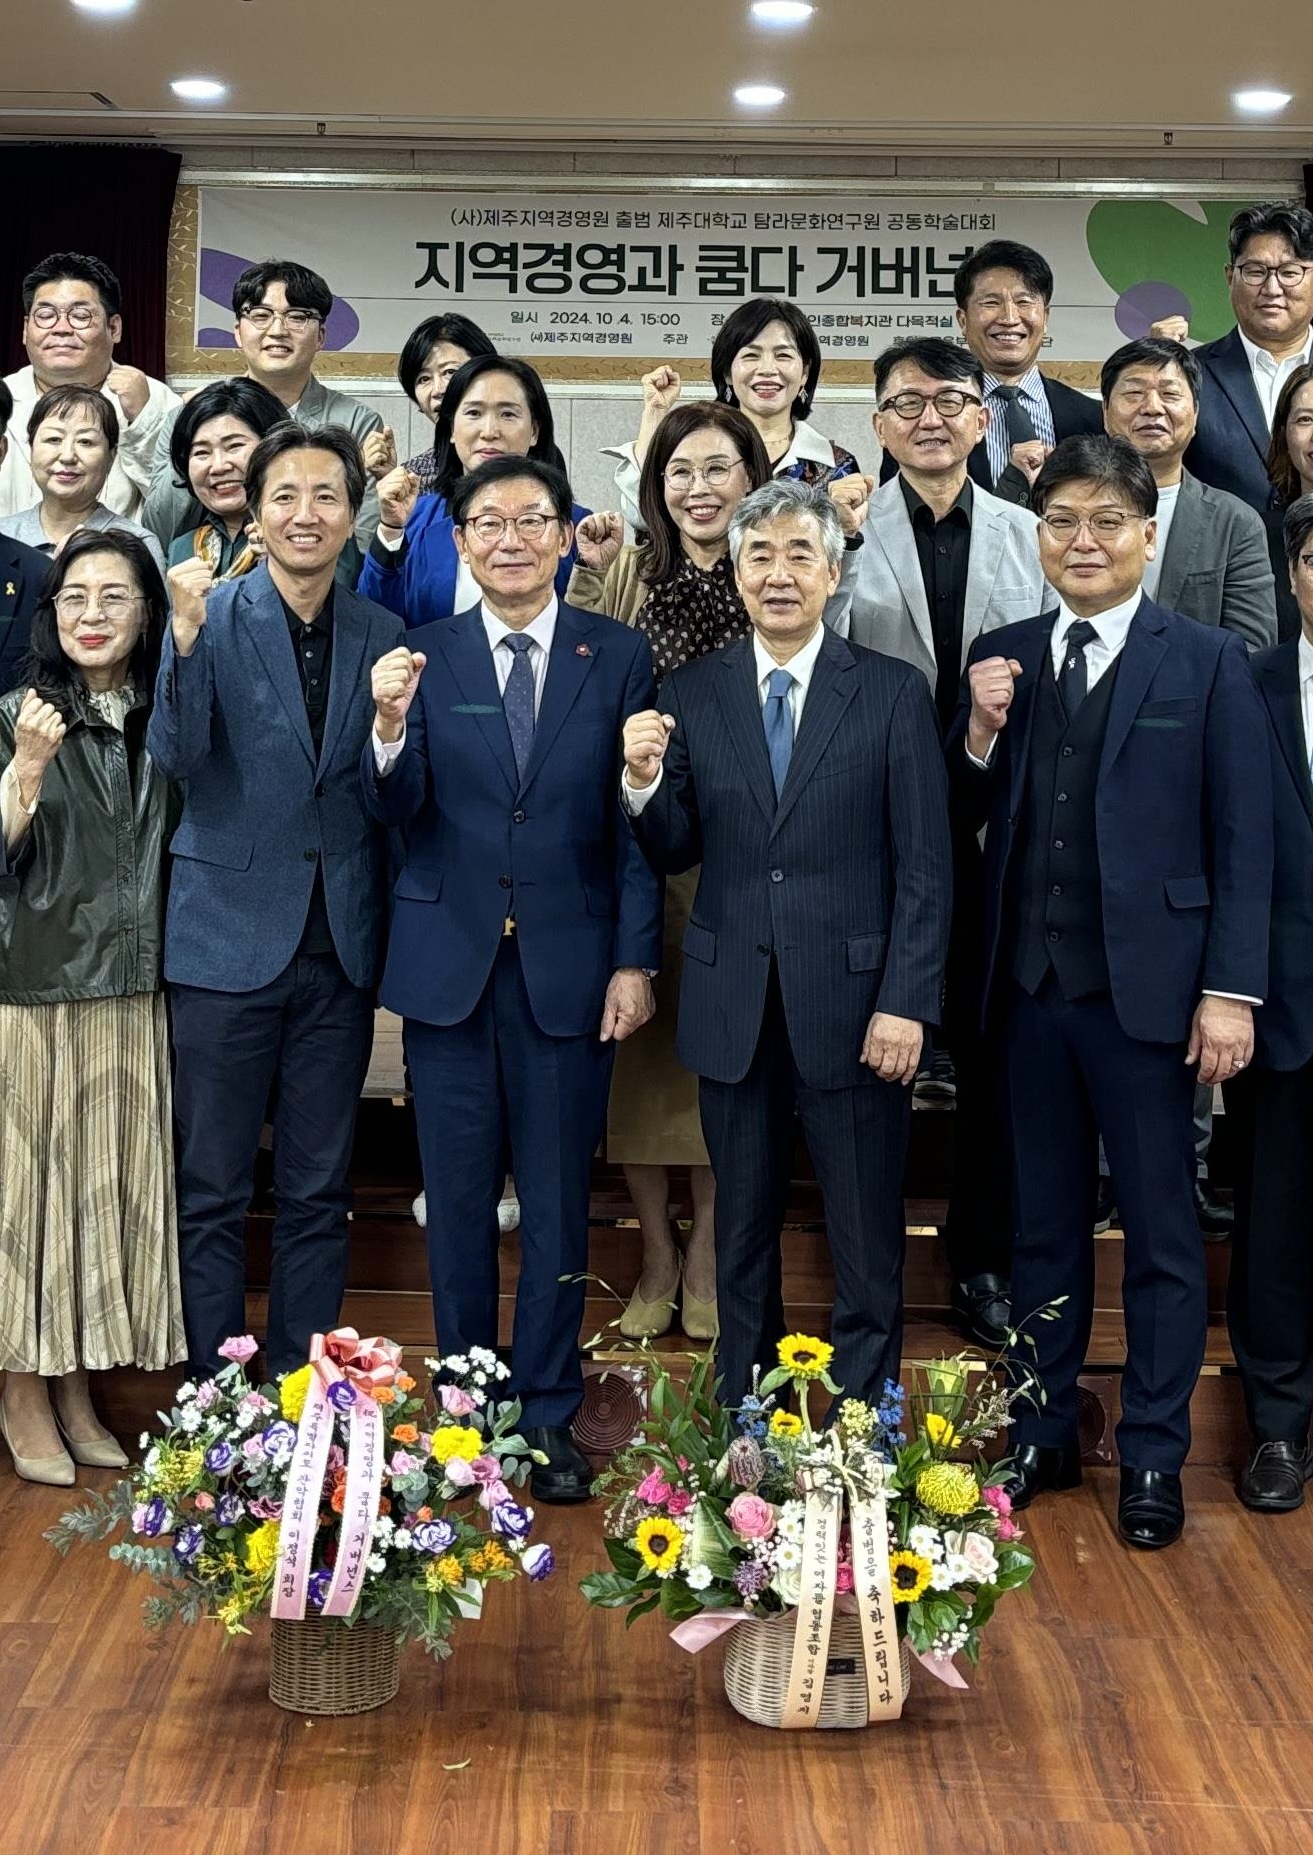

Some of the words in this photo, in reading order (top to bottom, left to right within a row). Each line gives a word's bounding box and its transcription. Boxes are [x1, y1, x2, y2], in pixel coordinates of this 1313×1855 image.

[450, 207, 610, 229] (사)제주지역경영원
[615, 210, 651, 230] 출범
[657, 211, 748, 231] 제주대학교
[753, 212, 881, 232] 탐라문화연구원
[886, 213, 996, 233] 공동학술대회
[413, 240, 685, 298] 지역경영과
[694, 244, 805, 298] 쿰다
[815, 245, 975, 299] 거버넌
[510, 311, 539, 325] 일시
[640, 313, 681, 326] 15:00
[710, 313, 726, 326] 장
[805, 313, 893, 328] 인종합복지관
[896, 314, 954, 328] 다목적실
[530, 331, 633, 345] (사)제주지역경영원
[662, 333, 689, 346] 주관
[341, 1532, 365, 1592] 거버넌스
